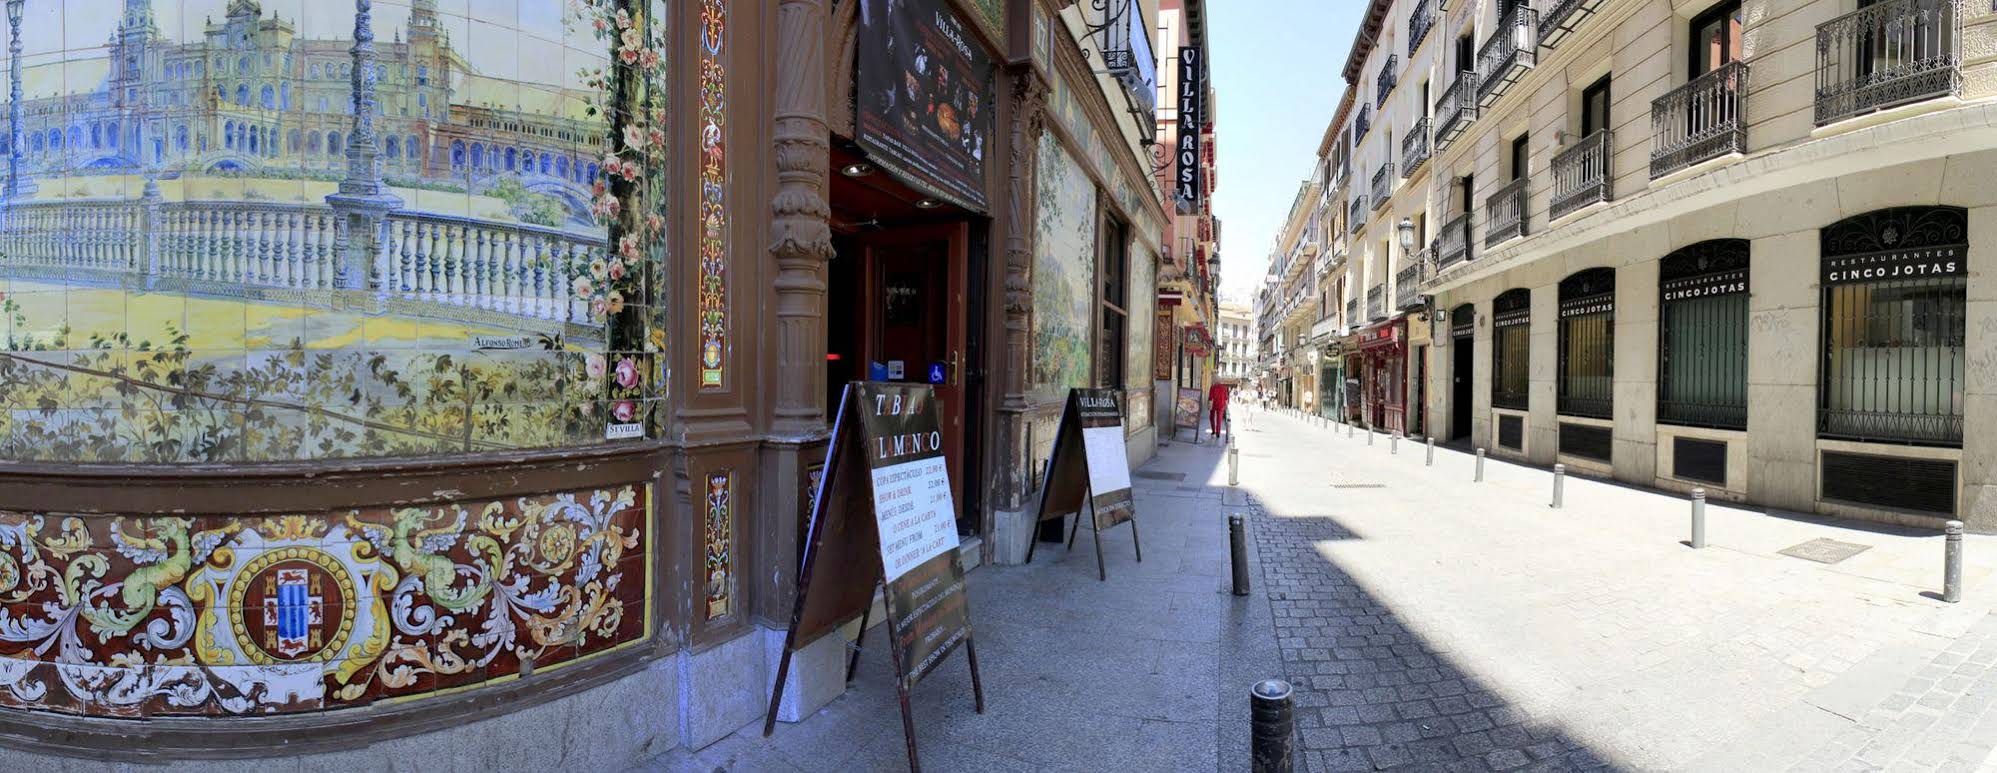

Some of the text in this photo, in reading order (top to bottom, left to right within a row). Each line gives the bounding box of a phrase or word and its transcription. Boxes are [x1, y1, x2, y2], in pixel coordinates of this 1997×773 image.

[1181, 49, 1195, 199] VILLA ROSA
[1830, 249, 1954, 267] RESTAURANTES
[1665, 272, 1743, 289] RESTAURANTES
[1829, 262, 1956, 281] CINCO JOTAS
[1664, 282, 1745, 300] CINCO JOTAS
[1561, 303, 1613, 317] CINCO JOTAS
[876, 394, 925, 416] TABLAO
[872, 431, 940, 459] FLAMENCO
